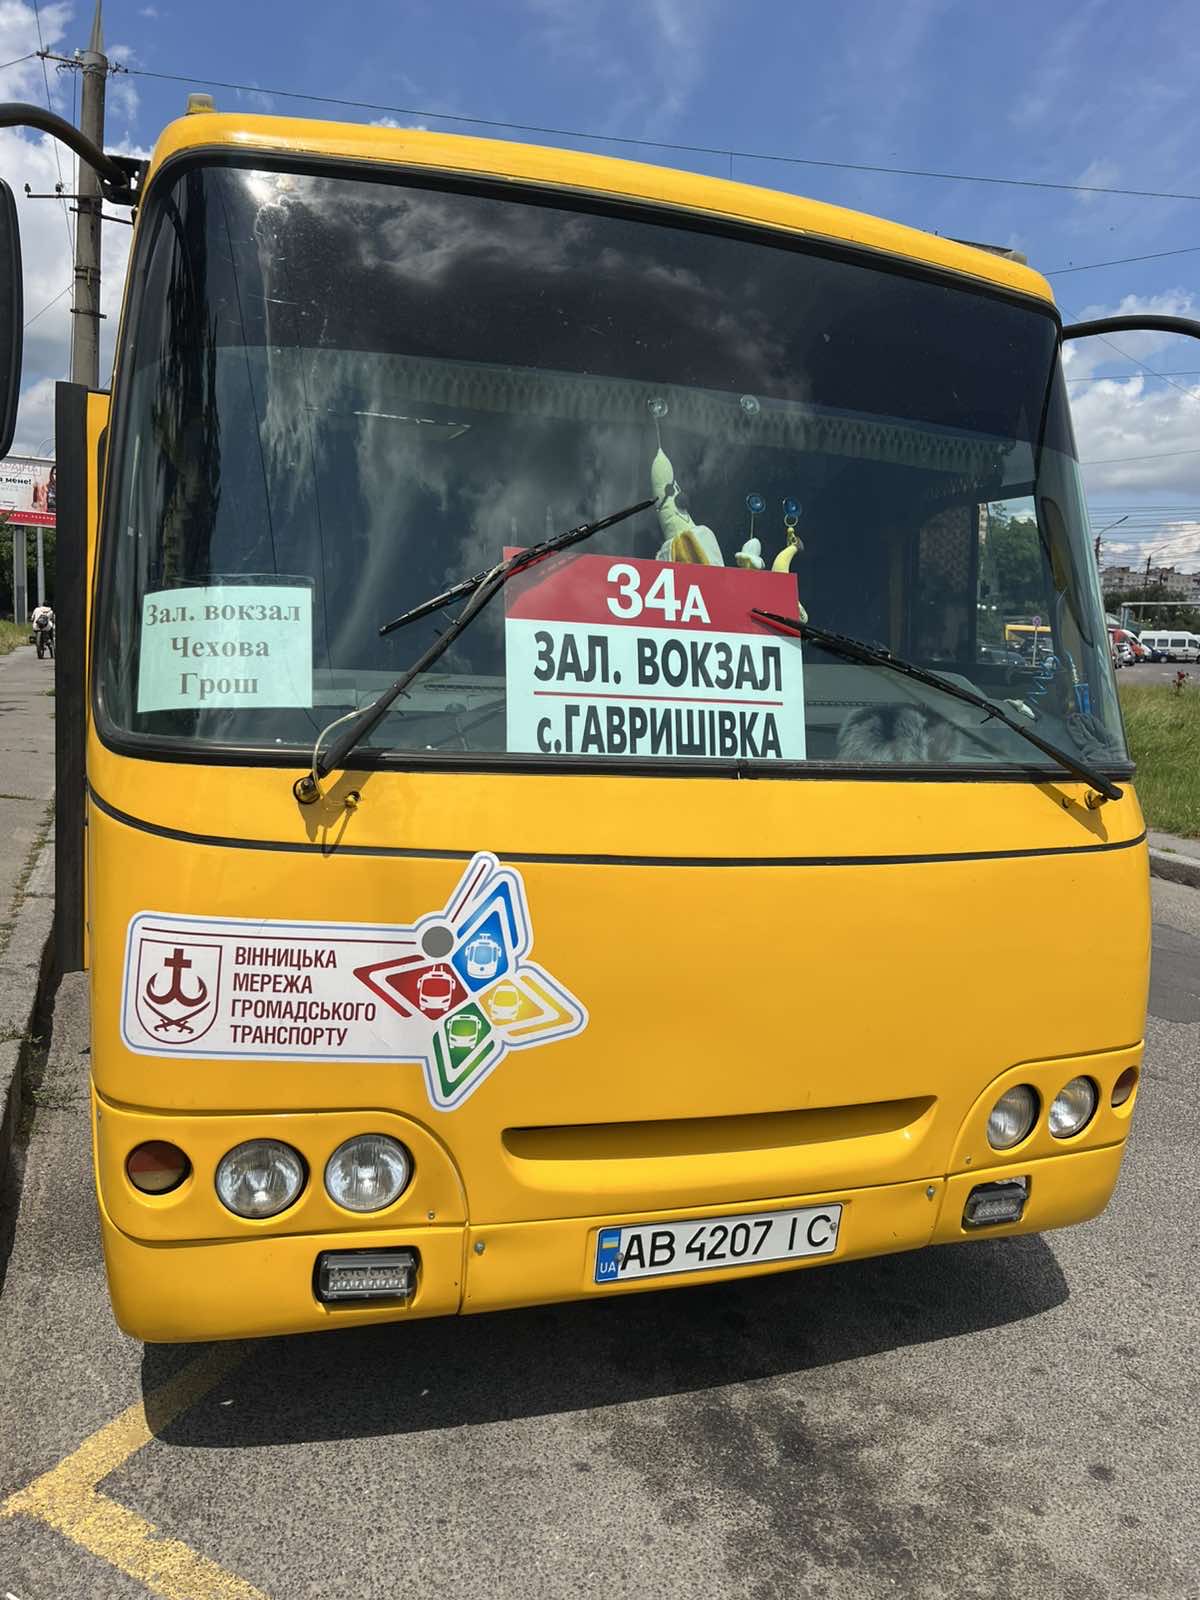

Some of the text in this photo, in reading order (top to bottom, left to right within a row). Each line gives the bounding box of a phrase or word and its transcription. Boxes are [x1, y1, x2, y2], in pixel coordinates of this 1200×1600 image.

[607, 563, 711, 624] 34А
[146, 603, 301, 626] Зал. вокзал
[171, 636, 270, 658] Чехова
[533, 630, 783, 692] ЗАЛ. ВОКЗАЛ
[178, 672, 259, 701] Грош
[536, 704, 784, 758] с.ГАВРИШІВКА
[234, 946, 337, 971] ВІННИЦЬКА
[232, 972, 313, 994] МЕРЕЖА
[231, 999, 376, 1023] ГРОМАДСЬКОГО
[229, 1024, 349, 1046] ТРАНСПОРТУ
[620, 1213, 832, 1271] AB 4207 IC
[599, 1262, 616, 1274] UA
